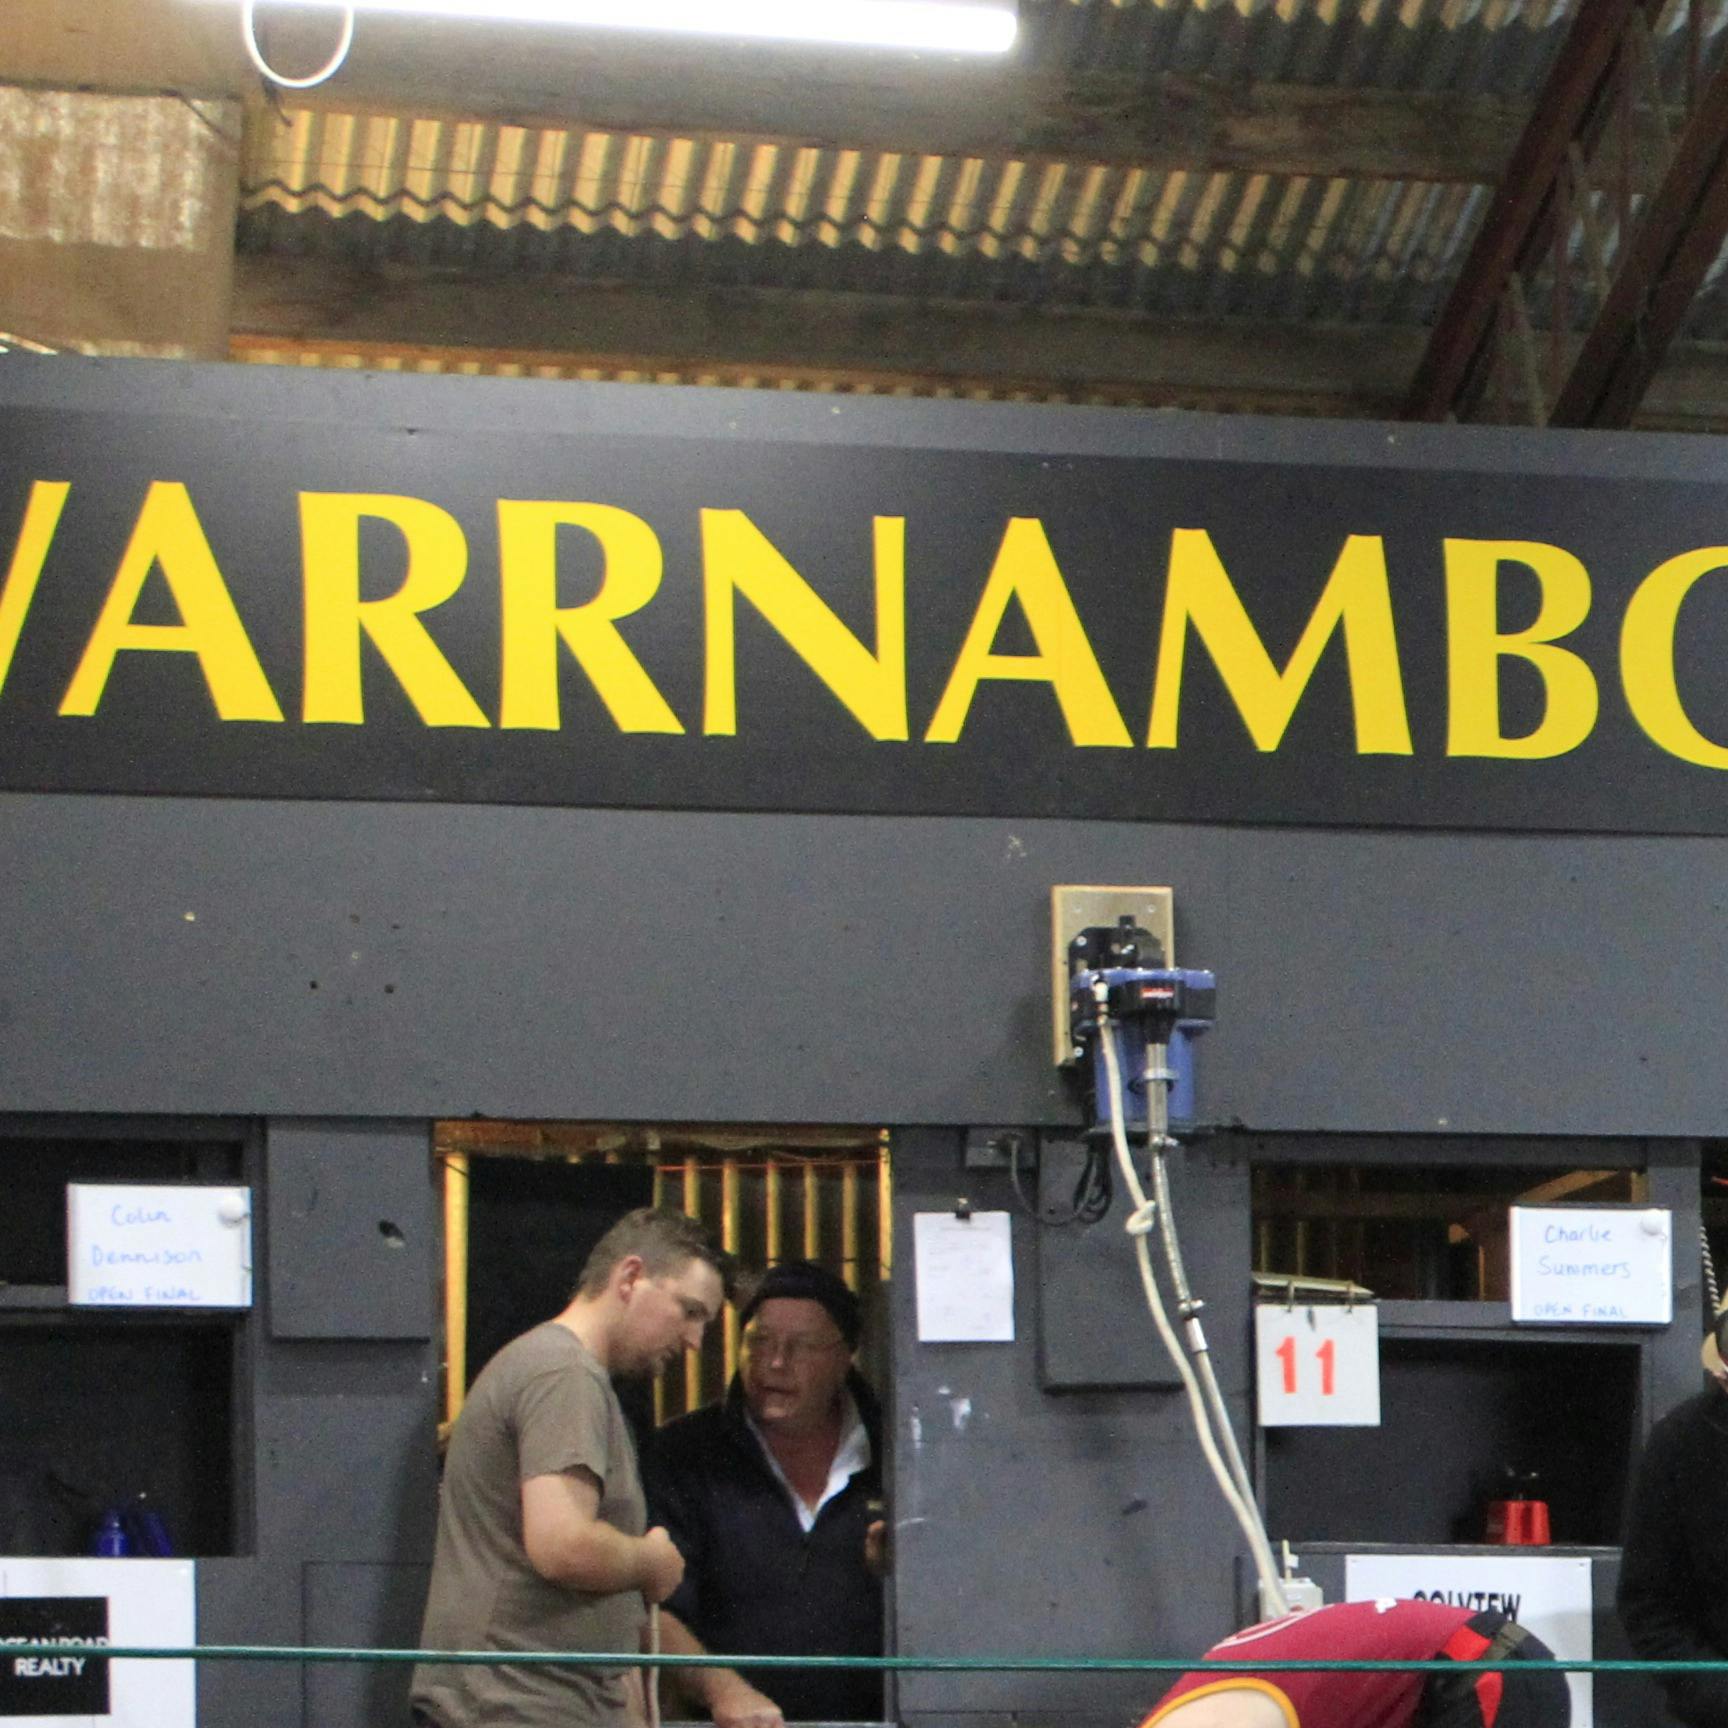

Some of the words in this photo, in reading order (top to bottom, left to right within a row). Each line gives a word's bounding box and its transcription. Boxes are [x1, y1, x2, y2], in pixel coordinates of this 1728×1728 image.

[111, 1203, 173, 1227] Colin
[1545, 1224, 1613, 1244] Charlie
[1538, 1255, 1632, 1279] Summers
[1275, 1335, 1336, 1396] 11
[14, 1656, 87, 1677] REALTY
